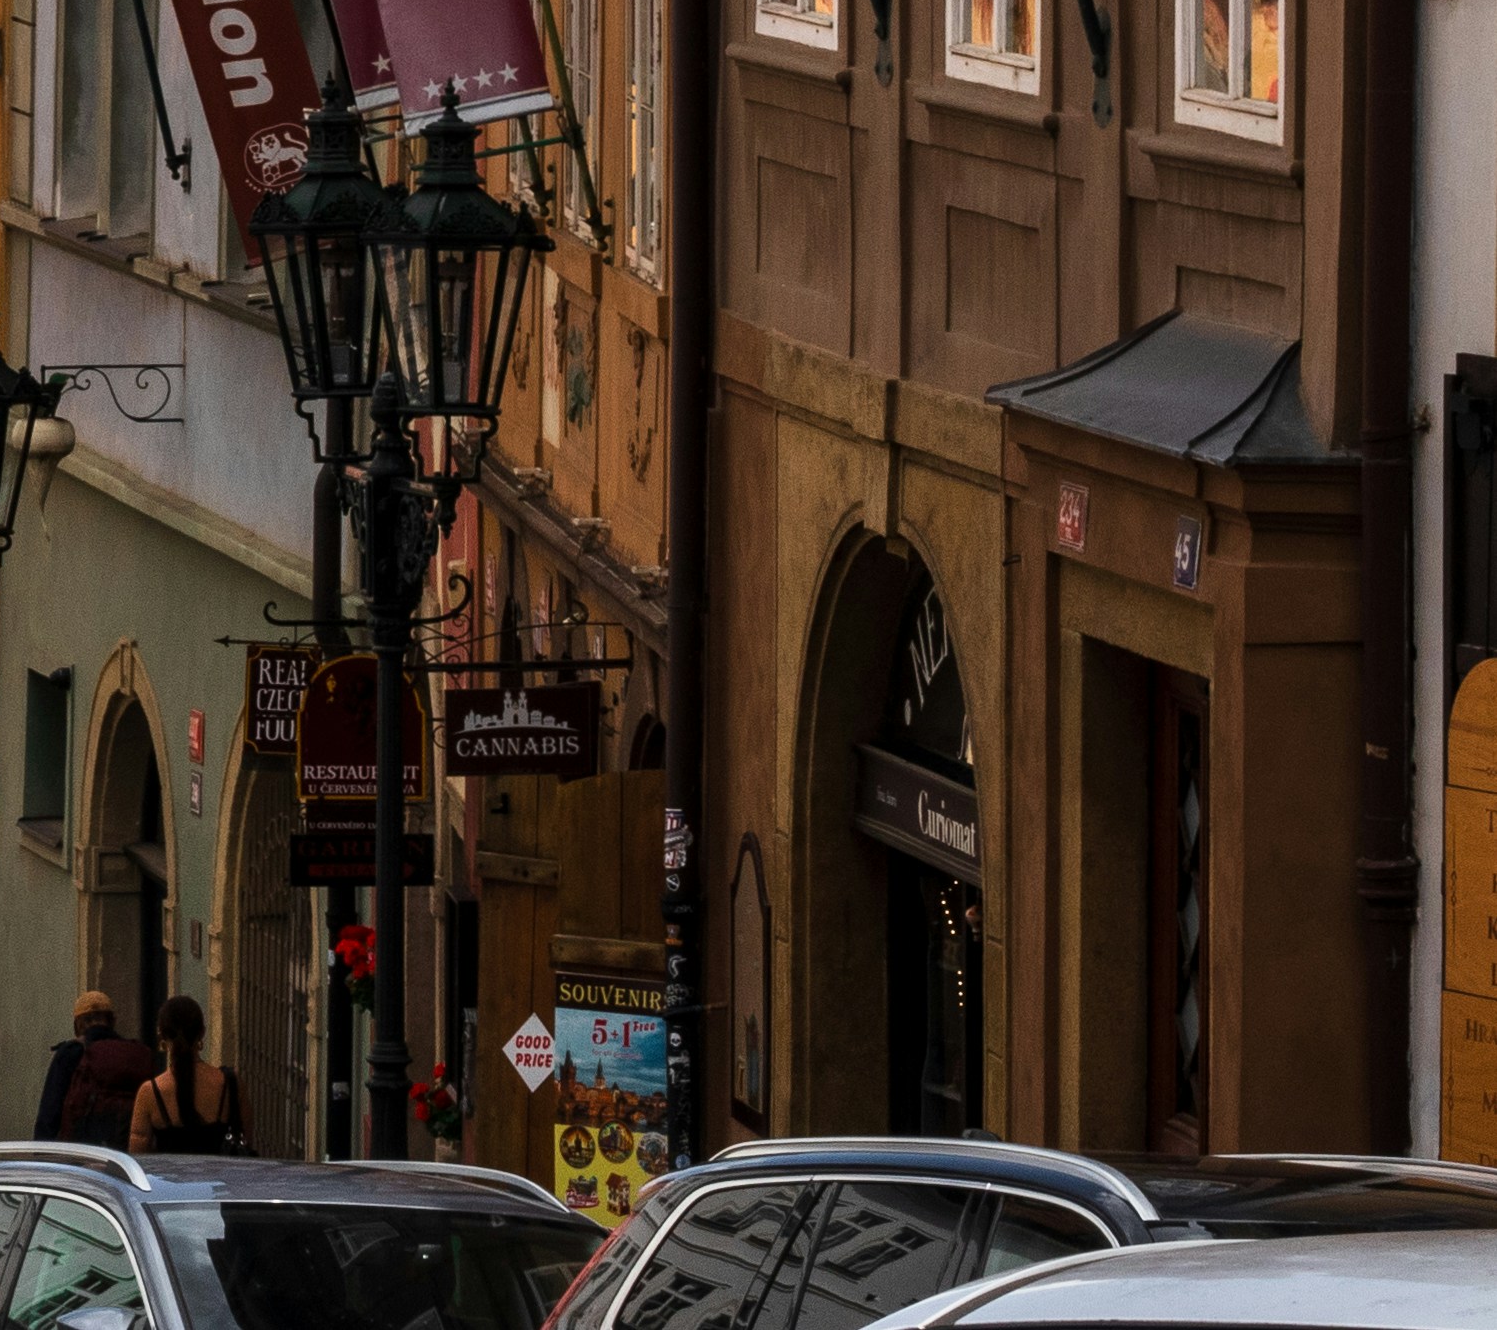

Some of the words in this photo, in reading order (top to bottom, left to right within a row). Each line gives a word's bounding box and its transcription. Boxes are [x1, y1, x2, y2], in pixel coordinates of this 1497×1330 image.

[1059, 490, 1081, 529] 234
[1175, 532, 1191, 571] 45
[456, 736, 580, 758] CANNABIS
[308, 784, 317, 794] U
[918, 789, 976, 858] Curiomat
[515, 1034, 551, 1050] GOOD
[515, 1052, 553, 1068] PRICE
